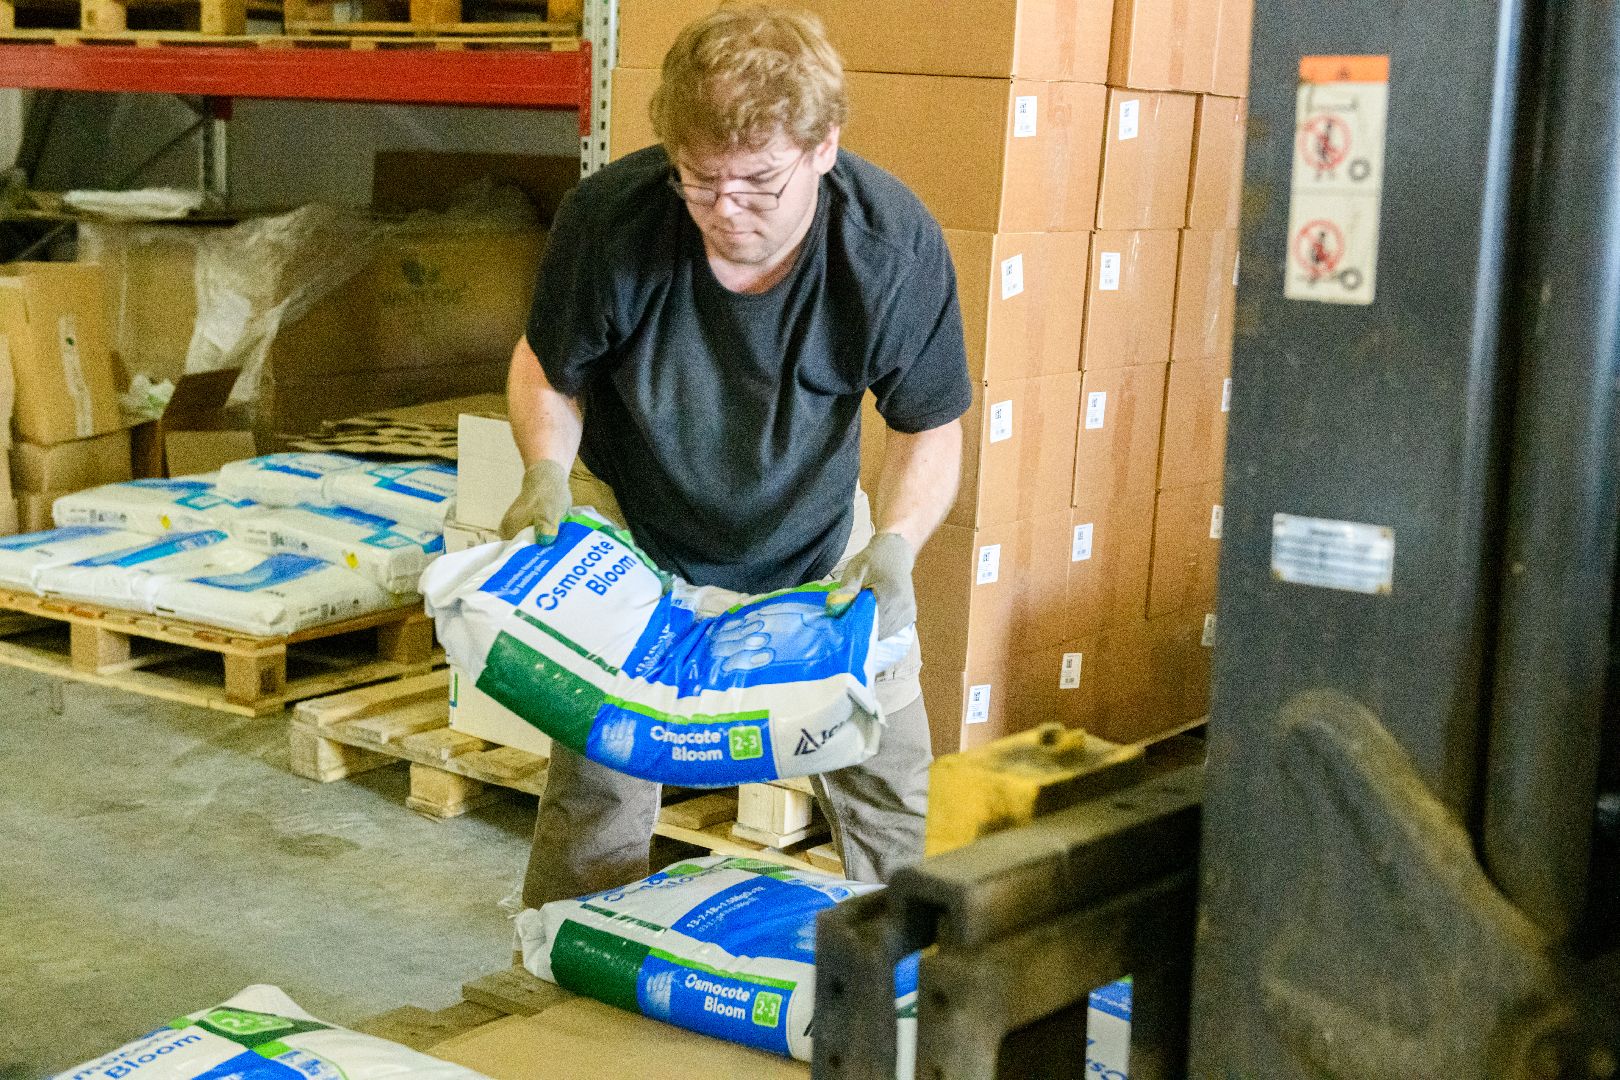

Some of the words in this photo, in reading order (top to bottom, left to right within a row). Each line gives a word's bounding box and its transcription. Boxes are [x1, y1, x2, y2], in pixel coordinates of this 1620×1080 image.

[535, 539, 616, 611] Osmocote
[585, 553, 638, 597] Bloom
[671, 745, 724, 762] Bloom
[733, 734, 758, 751] 2-3
[684, 973, 751, 1003] Osmocote
[703, 995, 746, 1021] Bloom
[756, 1000, 777, 1018] 2-3
[103, 1034, 203, 1080] Bloom
